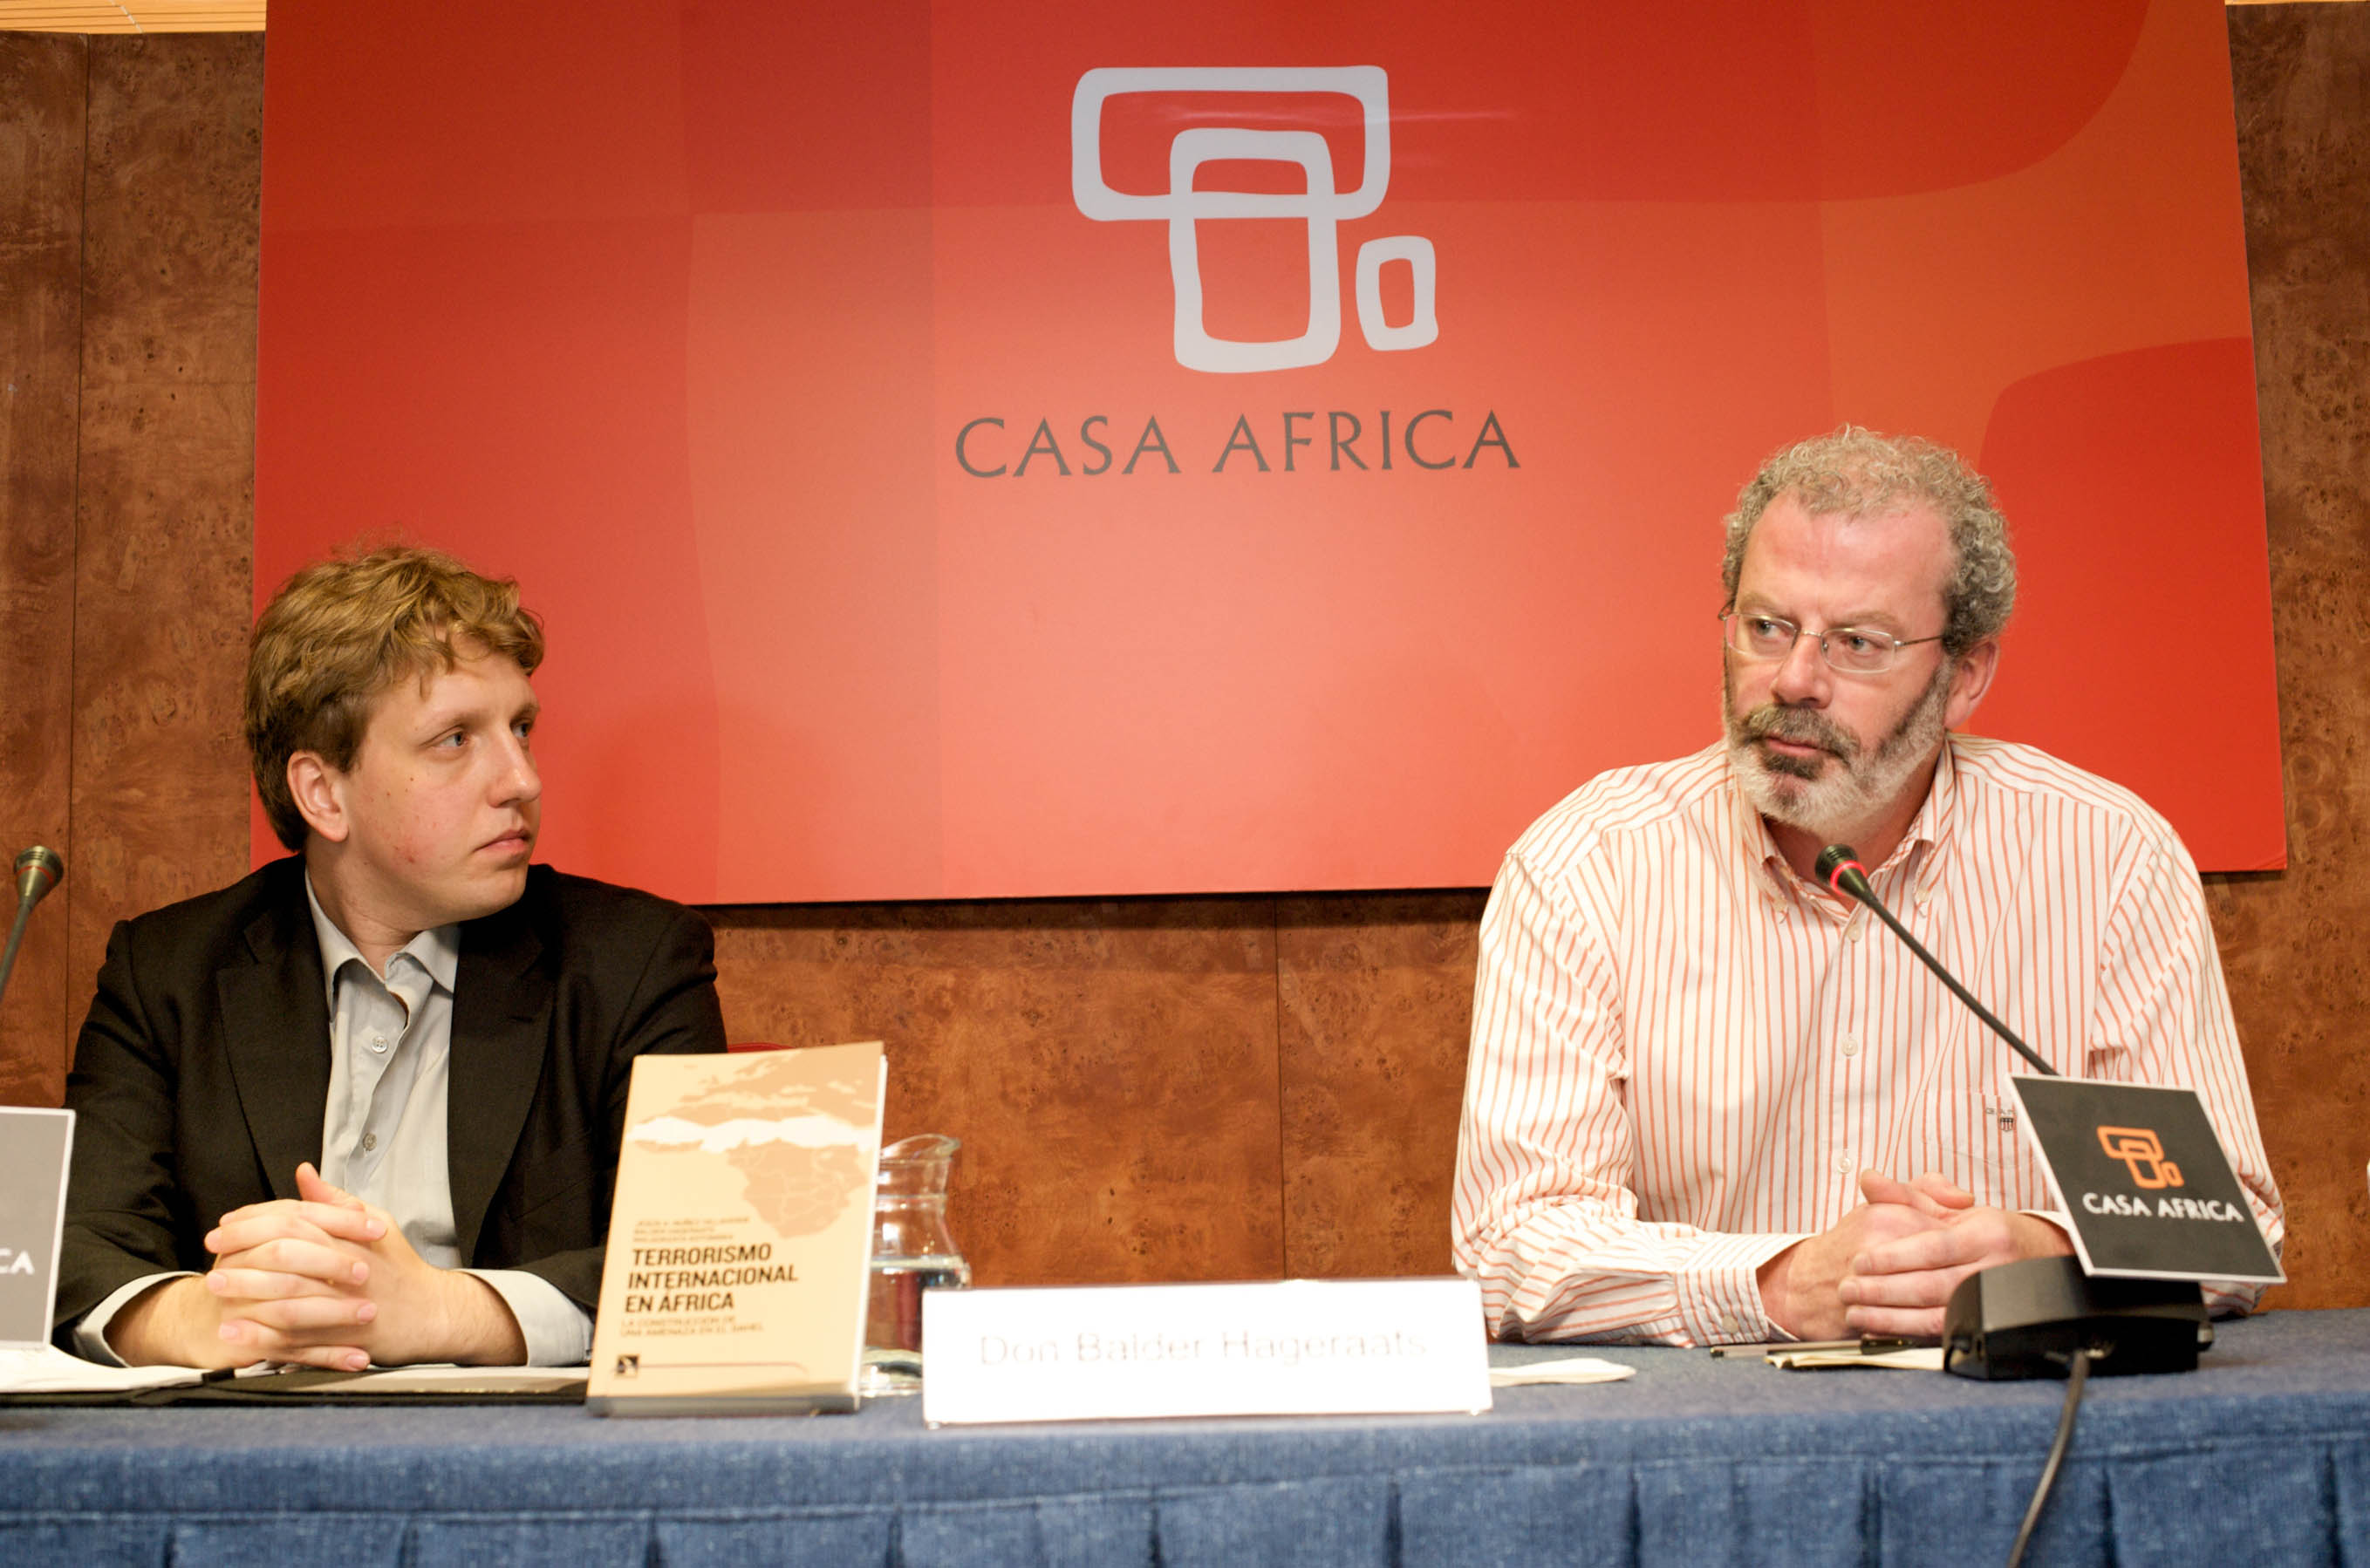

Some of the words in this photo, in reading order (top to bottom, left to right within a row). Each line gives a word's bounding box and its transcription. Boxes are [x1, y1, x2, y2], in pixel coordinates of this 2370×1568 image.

[955, 414, 1182, 478] CASA
[1211, 409, 1521, 474] AFRICA
[2082, 1192, 2151, 1218] CASA
[2157, 1196, 2245, 1223] AFRICA
[632, 1243, 773, 1266] TERRORISMO
[627, 1265, 798, 1290] INTERNACIONAL
[625, 1294, 653, 1313] EN
[658, 1287, 734, 1312] ÁFRICA
[979, 1333, 1062, 1367] Don
[1076, 1330, 1205, 1364] Balder
[1221, 1328, 1428, 1367] Hageraats
